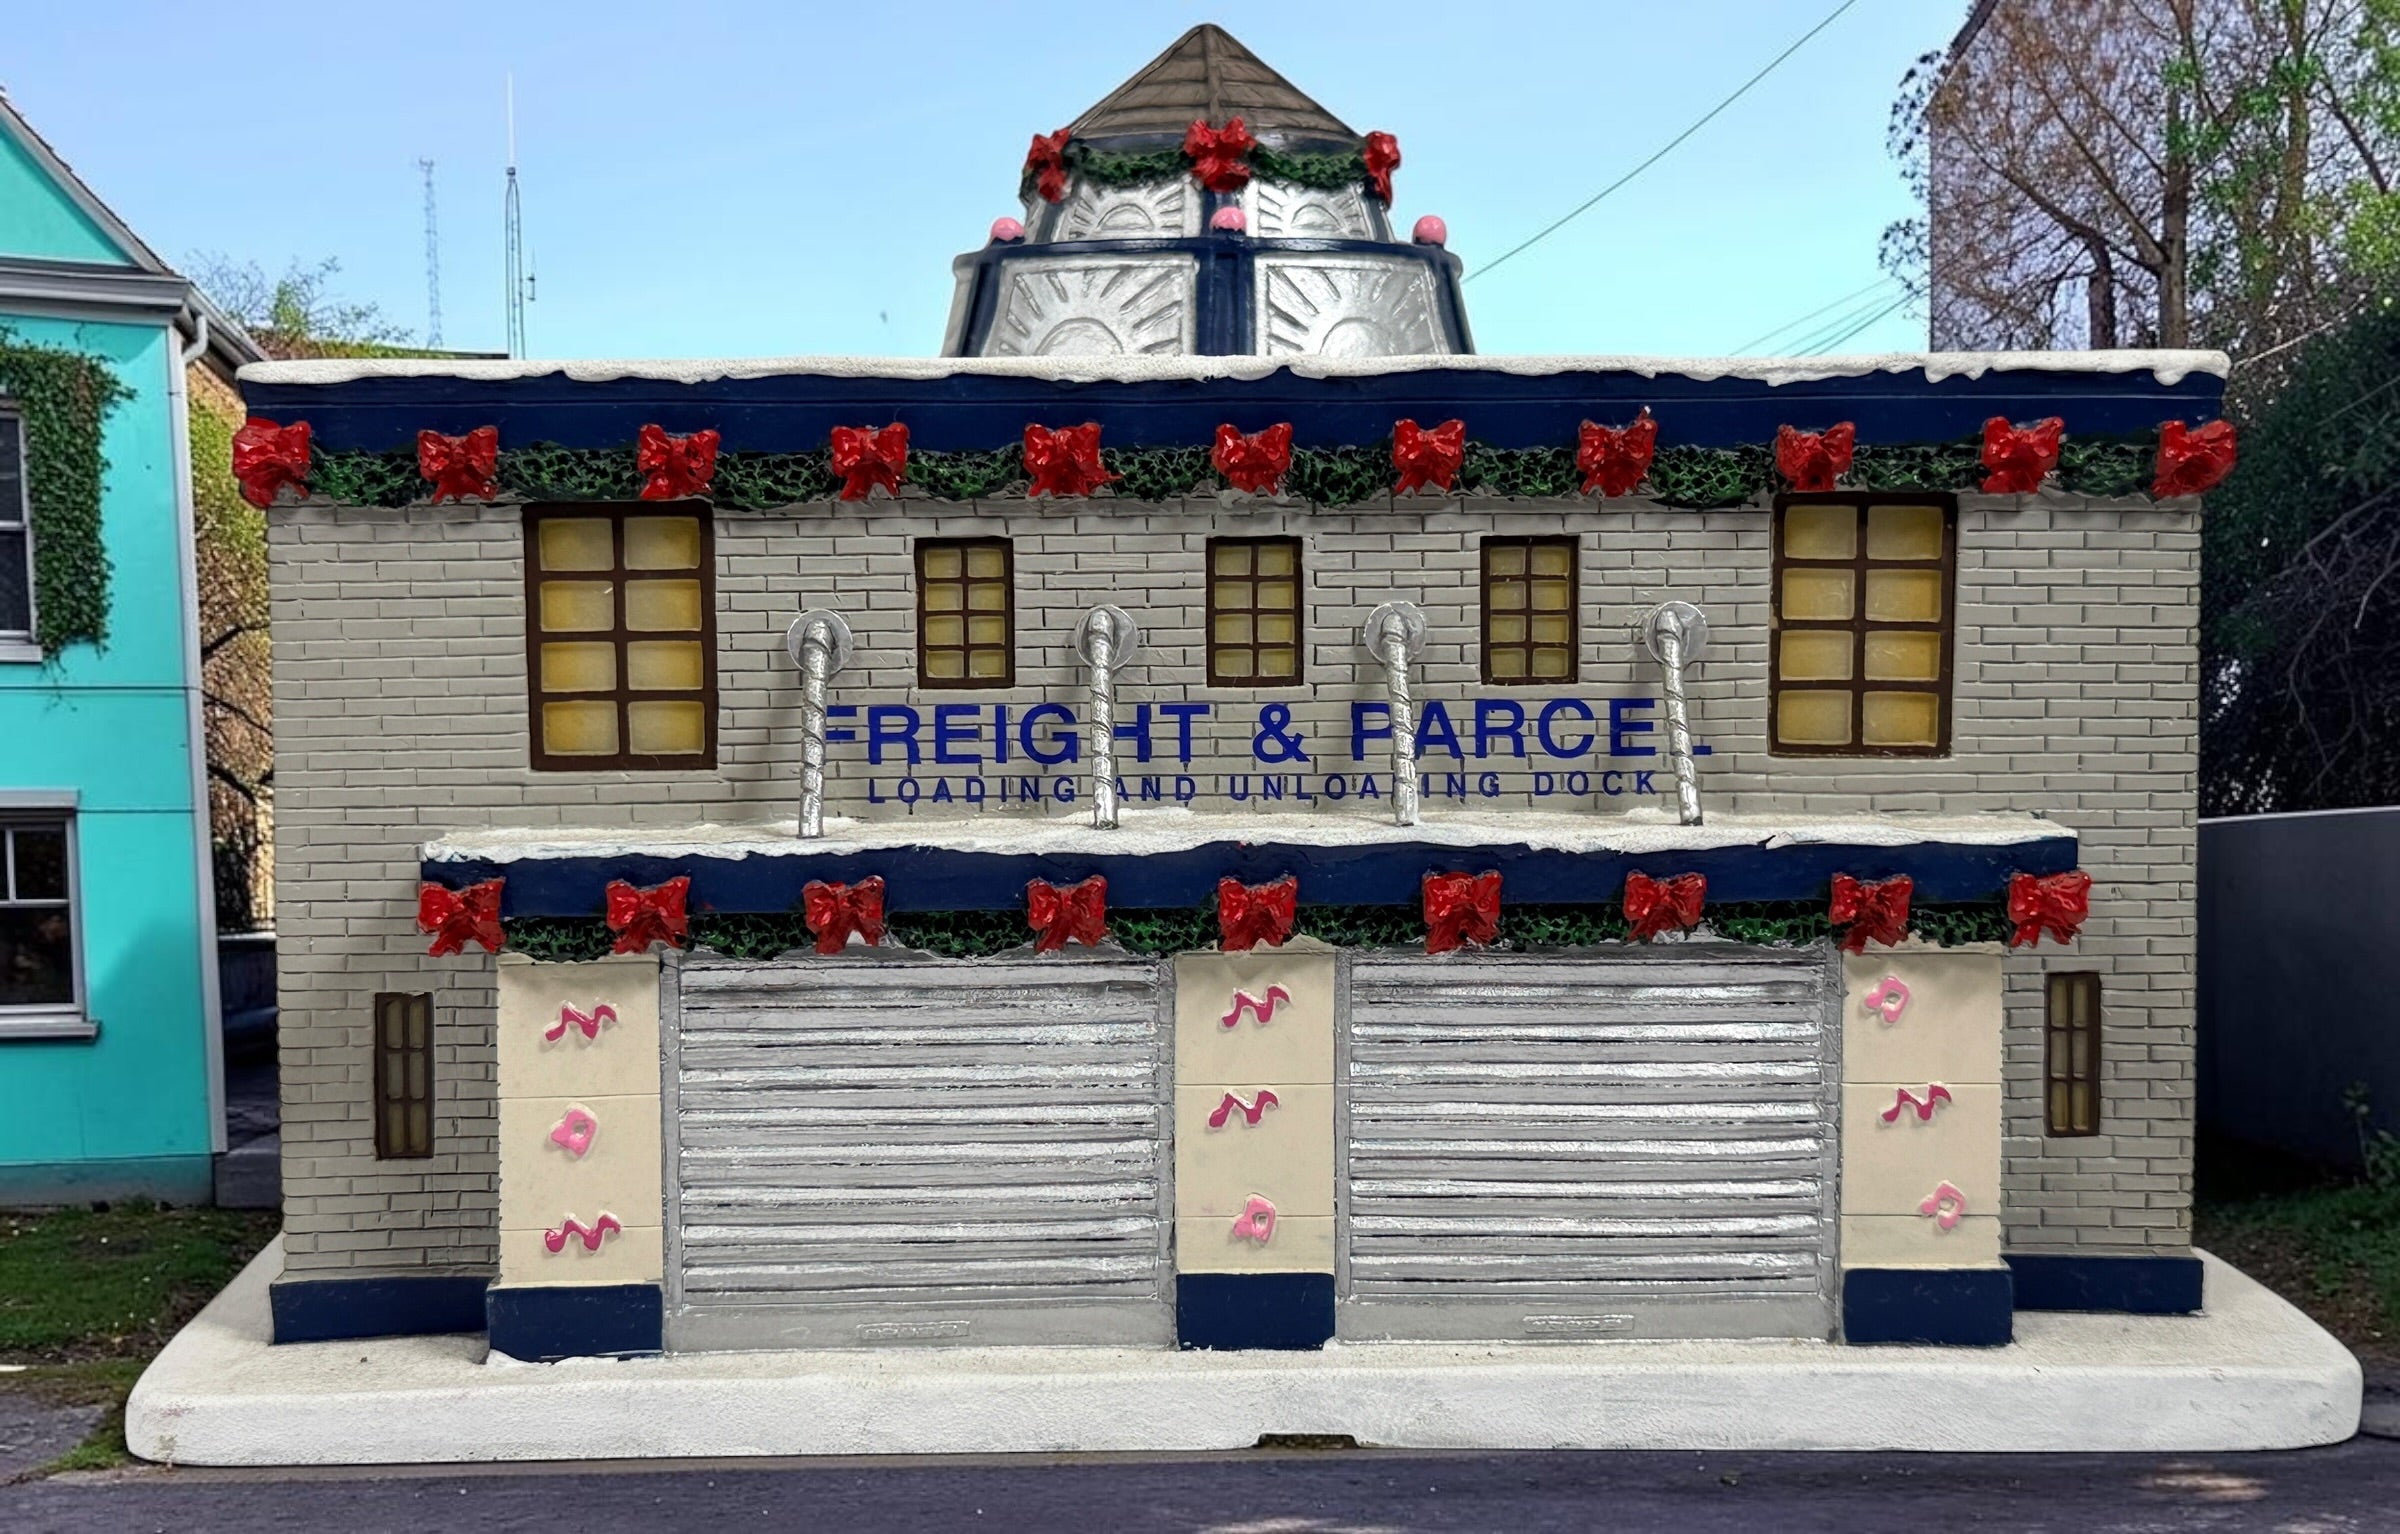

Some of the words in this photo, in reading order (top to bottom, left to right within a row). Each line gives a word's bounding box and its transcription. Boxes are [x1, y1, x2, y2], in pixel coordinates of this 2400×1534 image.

[1252, 702, 1310, 764] &
[1352, 698, 1712, 761] PARCE
[869, 776, 1076, 804] LOADING
[1116, 775, 1196, 802] AND
[1229, 773, 1501, 801] UNLOAING
[1535, 770, 1656, 796] DOCK
